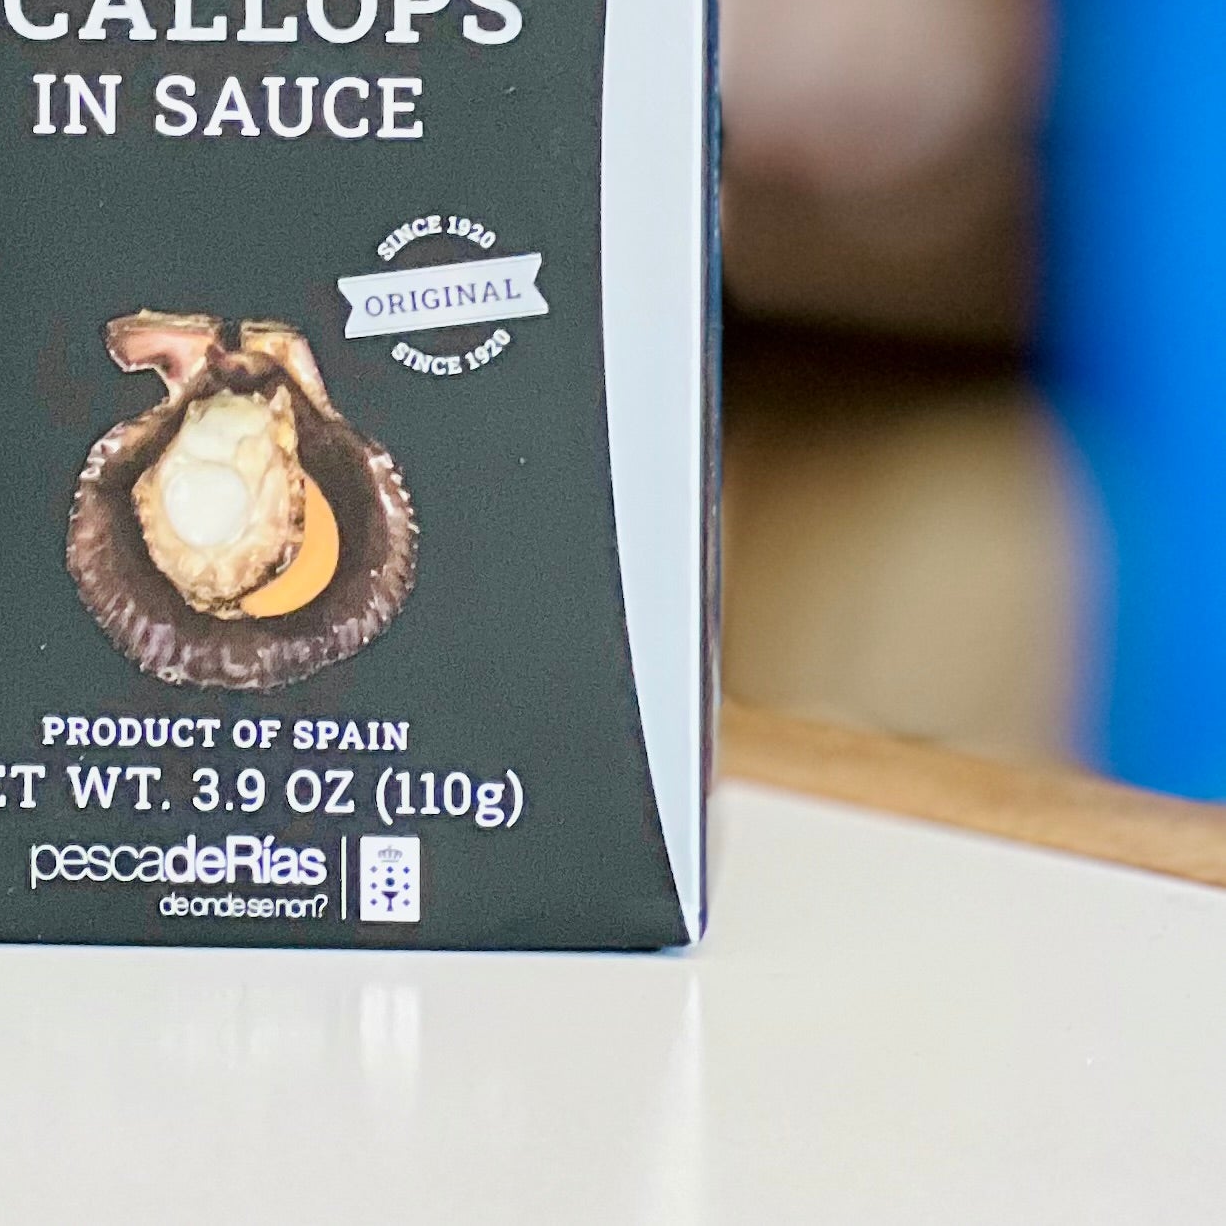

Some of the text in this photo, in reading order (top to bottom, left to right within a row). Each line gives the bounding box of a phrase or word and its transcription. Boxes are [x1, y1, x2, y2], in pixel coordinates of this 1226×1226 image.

[32, 73, 425, 139] IN SAUCE
[377, 214, 497, 262] SINCE 1920
[364, 278, 522, 317] ORIGINAL
[391, 328, 511, 376] SINCE 1920
[41, 716, 410, 752] PRODUCT OF SPAIN
[70, 765, 172, 812] WT.
[191, 768, 267, 814] 3.9
[286, 770, 356, 815] OZ
[375, 767, 525, 829] (110g)
[30, 834, 328, 890] pescadeRías
